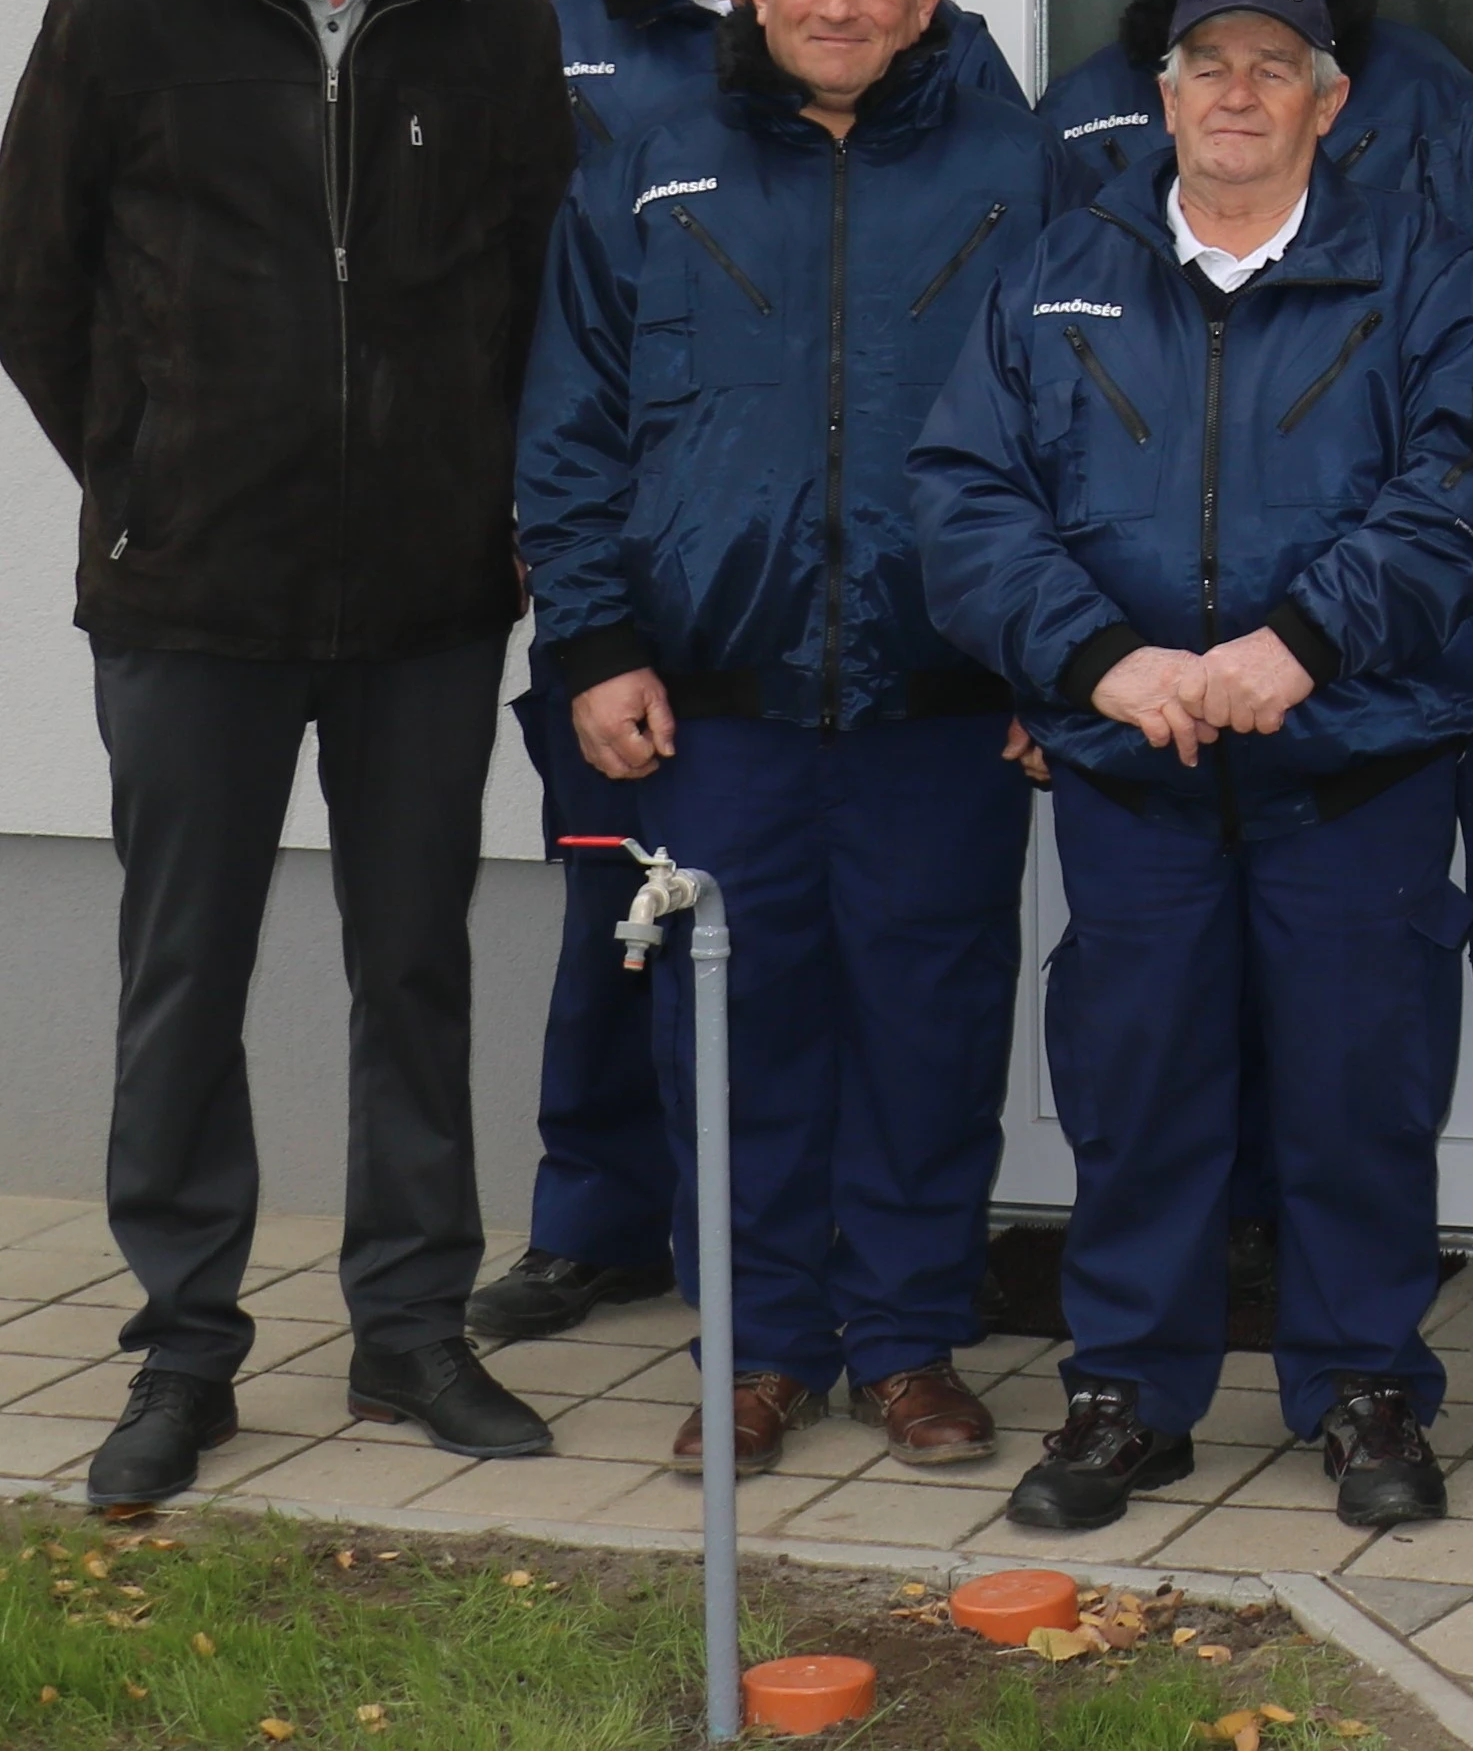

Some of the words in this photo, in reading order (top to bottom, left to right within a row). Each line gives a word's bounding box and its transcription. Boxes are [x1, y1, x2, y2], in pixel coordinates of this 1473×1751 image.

[563, 61, 616, 77] RŐRSÉG
[1063, 112, 1149, 140] POLGÁRŐRSÉG
[632, 177, 718, 214] GÁRŐRSÉG
[1032, 298, 1123, 317] LGÁRŐRSÉG
